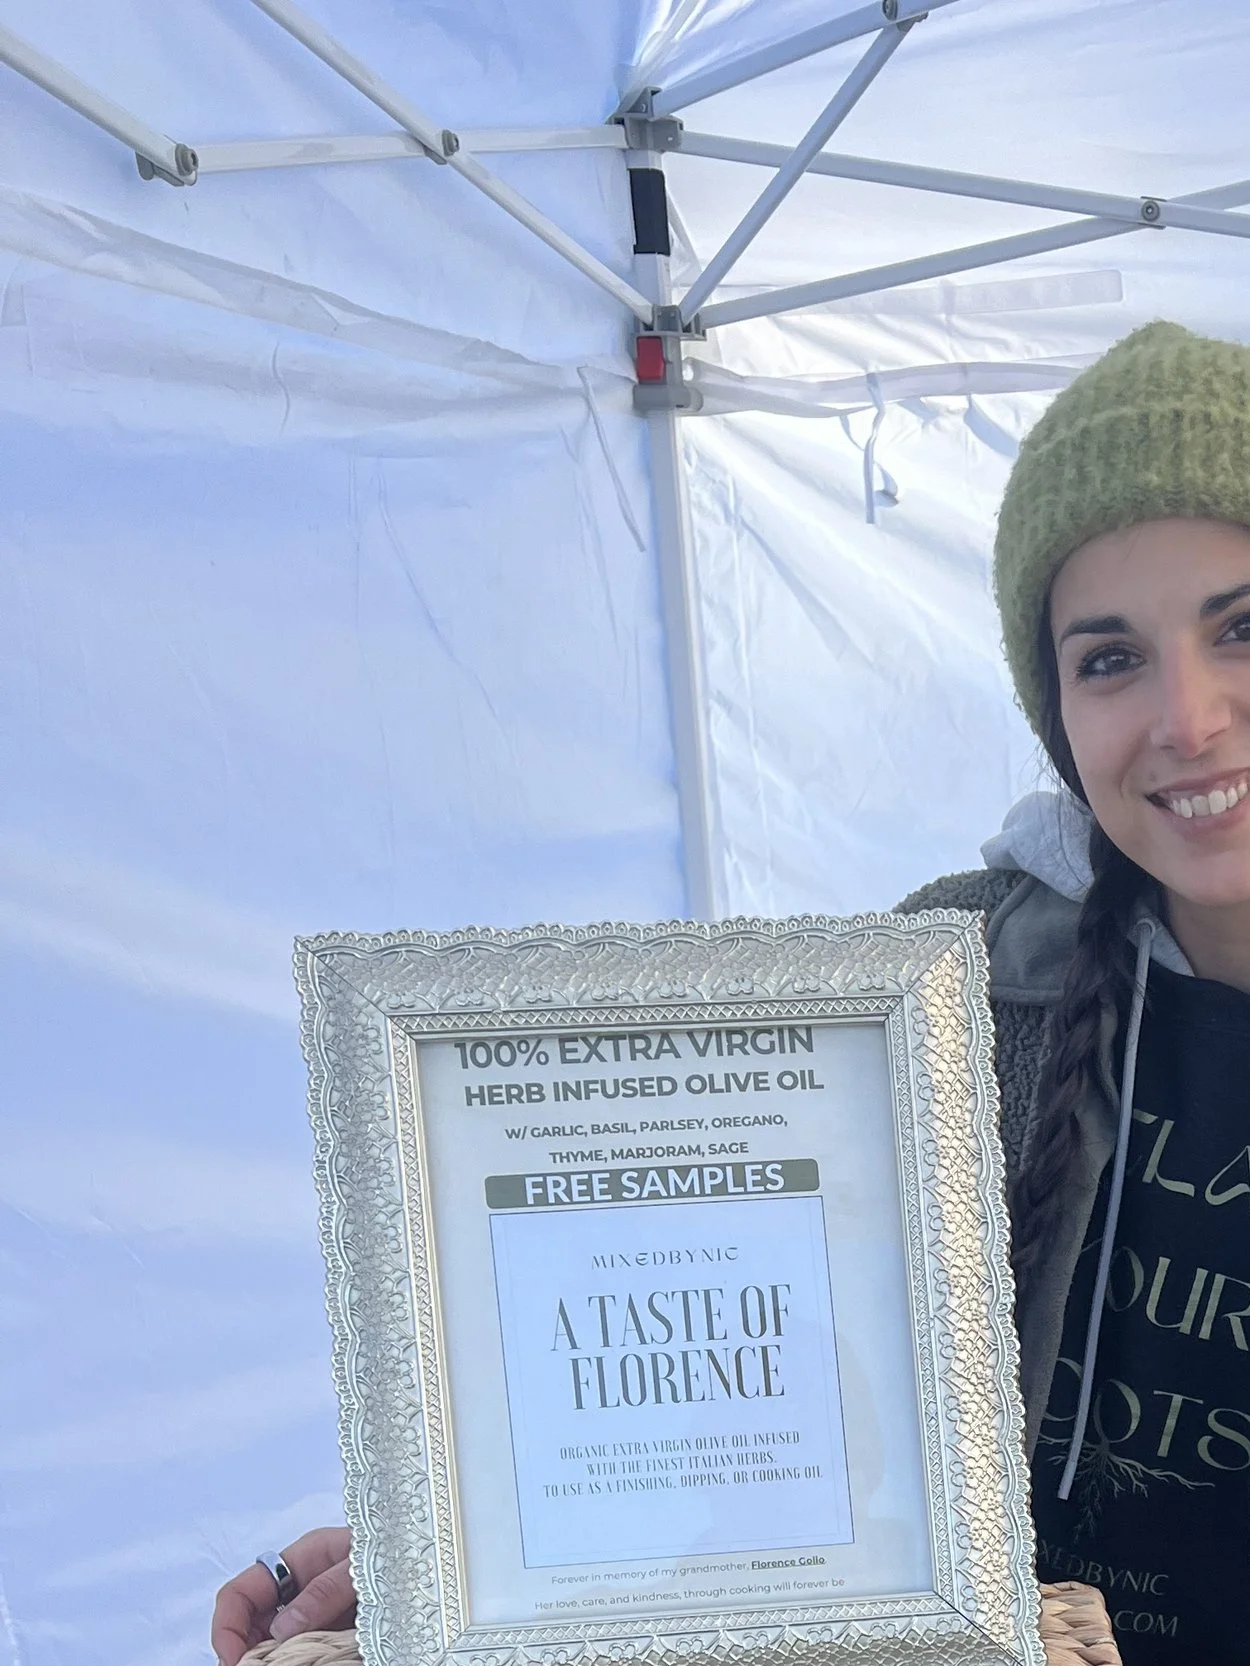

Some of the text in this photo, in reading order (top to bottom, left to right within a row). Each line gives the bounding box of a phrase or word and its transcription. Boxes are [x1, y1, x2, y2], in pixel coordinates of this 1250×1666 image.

[454, 1026, 814, 1070] 100% EXTRA VIRGIN
[465, 1069, 825, 1106] HERB INFUSED OLIVE OIL
[505, 1114, 788, 1140] W/ GARLIC, BASIL, PARLSEY, OREGANO,
[549, 1142, 749, 1164] THYME, MARJORAM, SAGE
[523, 1163, 785, 1205] FREE SAMPLES
[591, 1247, 739, 1270] MIXEDBYNIC
[550, 1283, 792, 1352] A TASTE OF
[568, 1344, 786, 1411] FLORENCE
[560, 1431, 800, 1460] ORGANIC EXTRA VIRGIN OLIVE OIL INFUSED
[586, 1462, 616, 1476] WITH
[620, 1460, 641, 1474] THE
[646, 1457, 684, 1472] FINEST
[689, 1454, 733, 1470] ITALIAN
[543, 1484, 559, 1498] TO
[562, 1483, 584, 1497] USE
[588, 1481, 601, 1494] AS
[733, 1471, 749, 1484] OR
[752, 1467, 801, 1483] COOKING
[551, 1574, 589, 1585] Forever
[592, 1573, 601, 1582] in
[603, 1571, 646, 1582] memory
[648, 1568, 658, 1578] of
[661, 1568, 677, 1579] my
[679, 1562, 750, 1577] grandmother,
[751, 1558, 796, 1570] Florence
[534, 1577, 845, 1610] Her love, care, and kindness, through cooking will forever be
